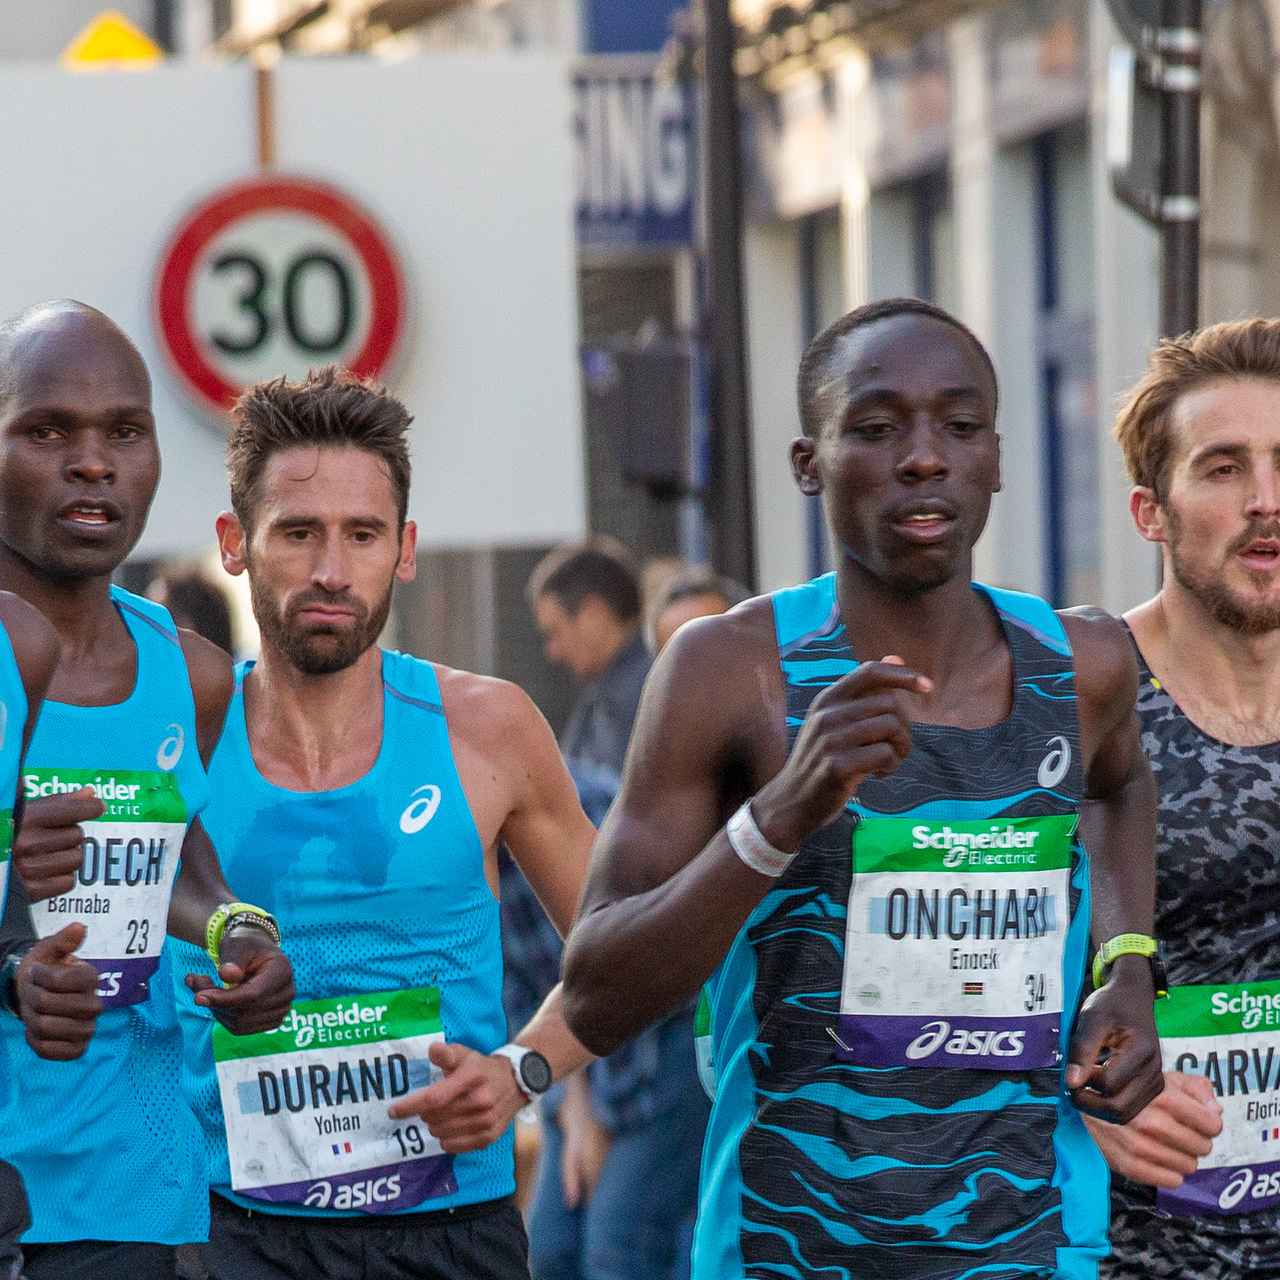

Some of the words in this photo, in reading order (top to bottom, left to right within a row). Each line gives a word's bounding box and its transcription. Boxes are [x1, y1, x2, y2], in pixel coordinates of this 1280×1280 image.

[572, 80, 690, 214] ING
[210, 252, 352, 357] 30
[912, 826, 1039, 850] Schneider
[78, 837, 166, 887] OECH
[969, 851, 1037, 866] Electric
[47, 894, 111, 915] Barnaba
[885, 886, 1049, 941] ONCHARI
[125, 919, 150, 955] 23
[950, 948, 1001, 971] Enock
[1024, 973, 1047, 1013] 34
[265, 1002, 388, 1035] chneider
[318, 1024, 389, 1043] Electric
[257, 1053, 411, 1117] DURAND
[314, 1114, 362, 1137] Yohan
[391, 1124, 426, 1157] 19
